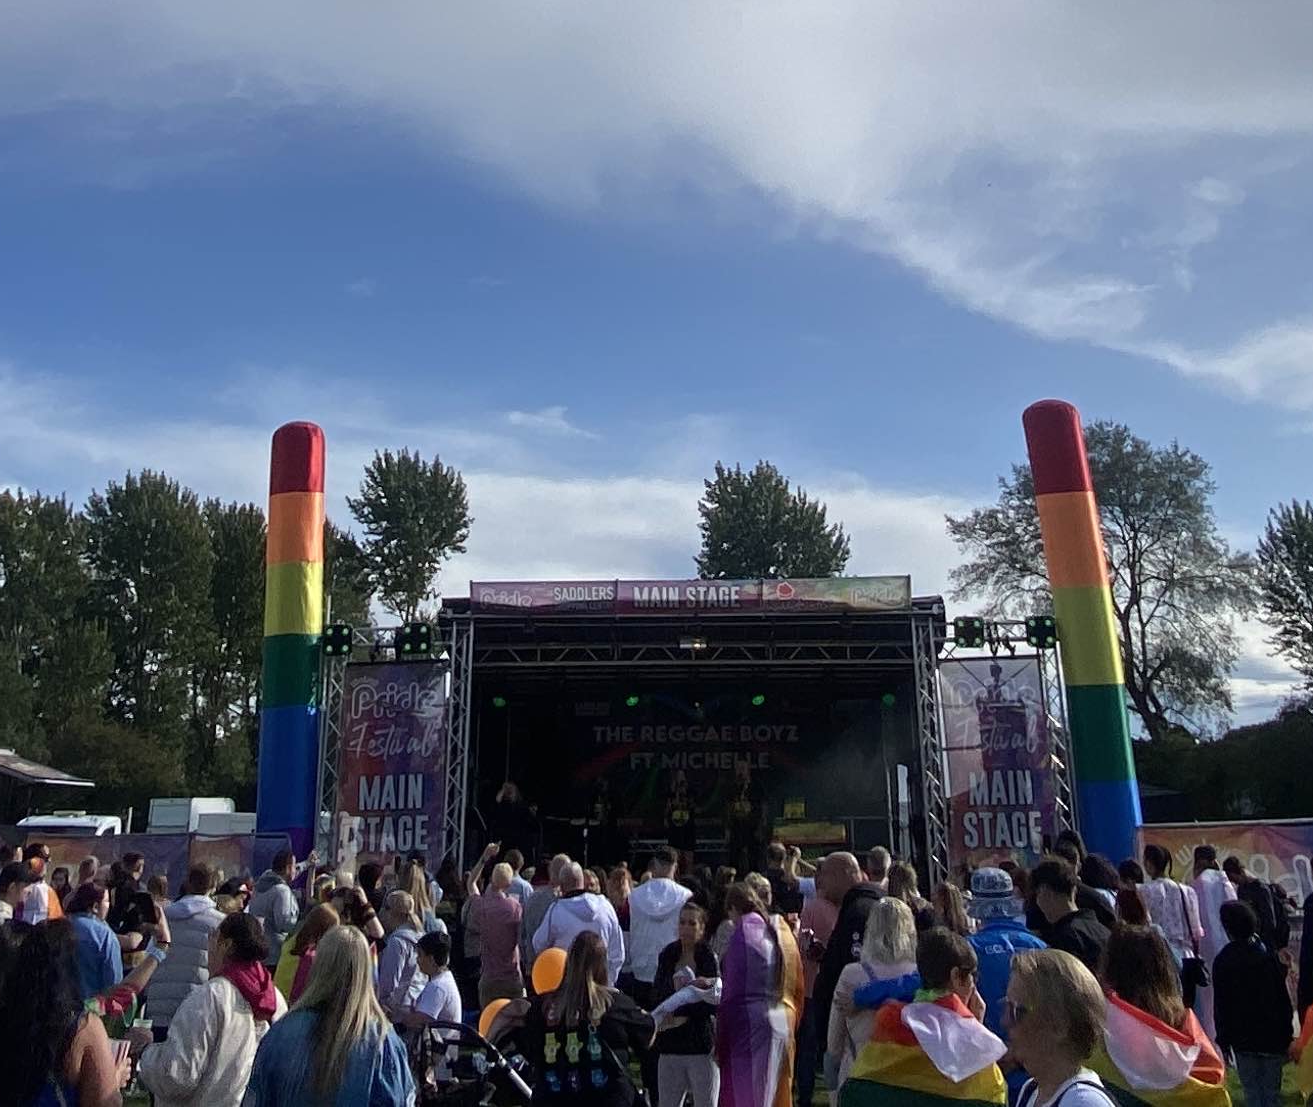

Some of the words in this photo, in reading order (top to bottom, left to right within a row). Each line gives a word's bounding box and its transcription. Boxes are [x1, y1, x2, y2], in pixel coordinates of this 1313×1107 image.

[553, 587, 614, 601] SADDLERS
[633, 587, 680, 608] MAIN
[686, 586, 741, 608] STAGE
[593, 725, 633, 743] THE
[640, 724, 732, 742] REGGAE
[740, 724, 799, 741] BOYZ
[630, 752, 654, 769] FT
[662, 751, 770, 769] MICHELLE
[358, 773, 423, 810] MAIN
[969, 769, 1033, 805] MAIN
[963, 811, 1041, 849] STAGE
